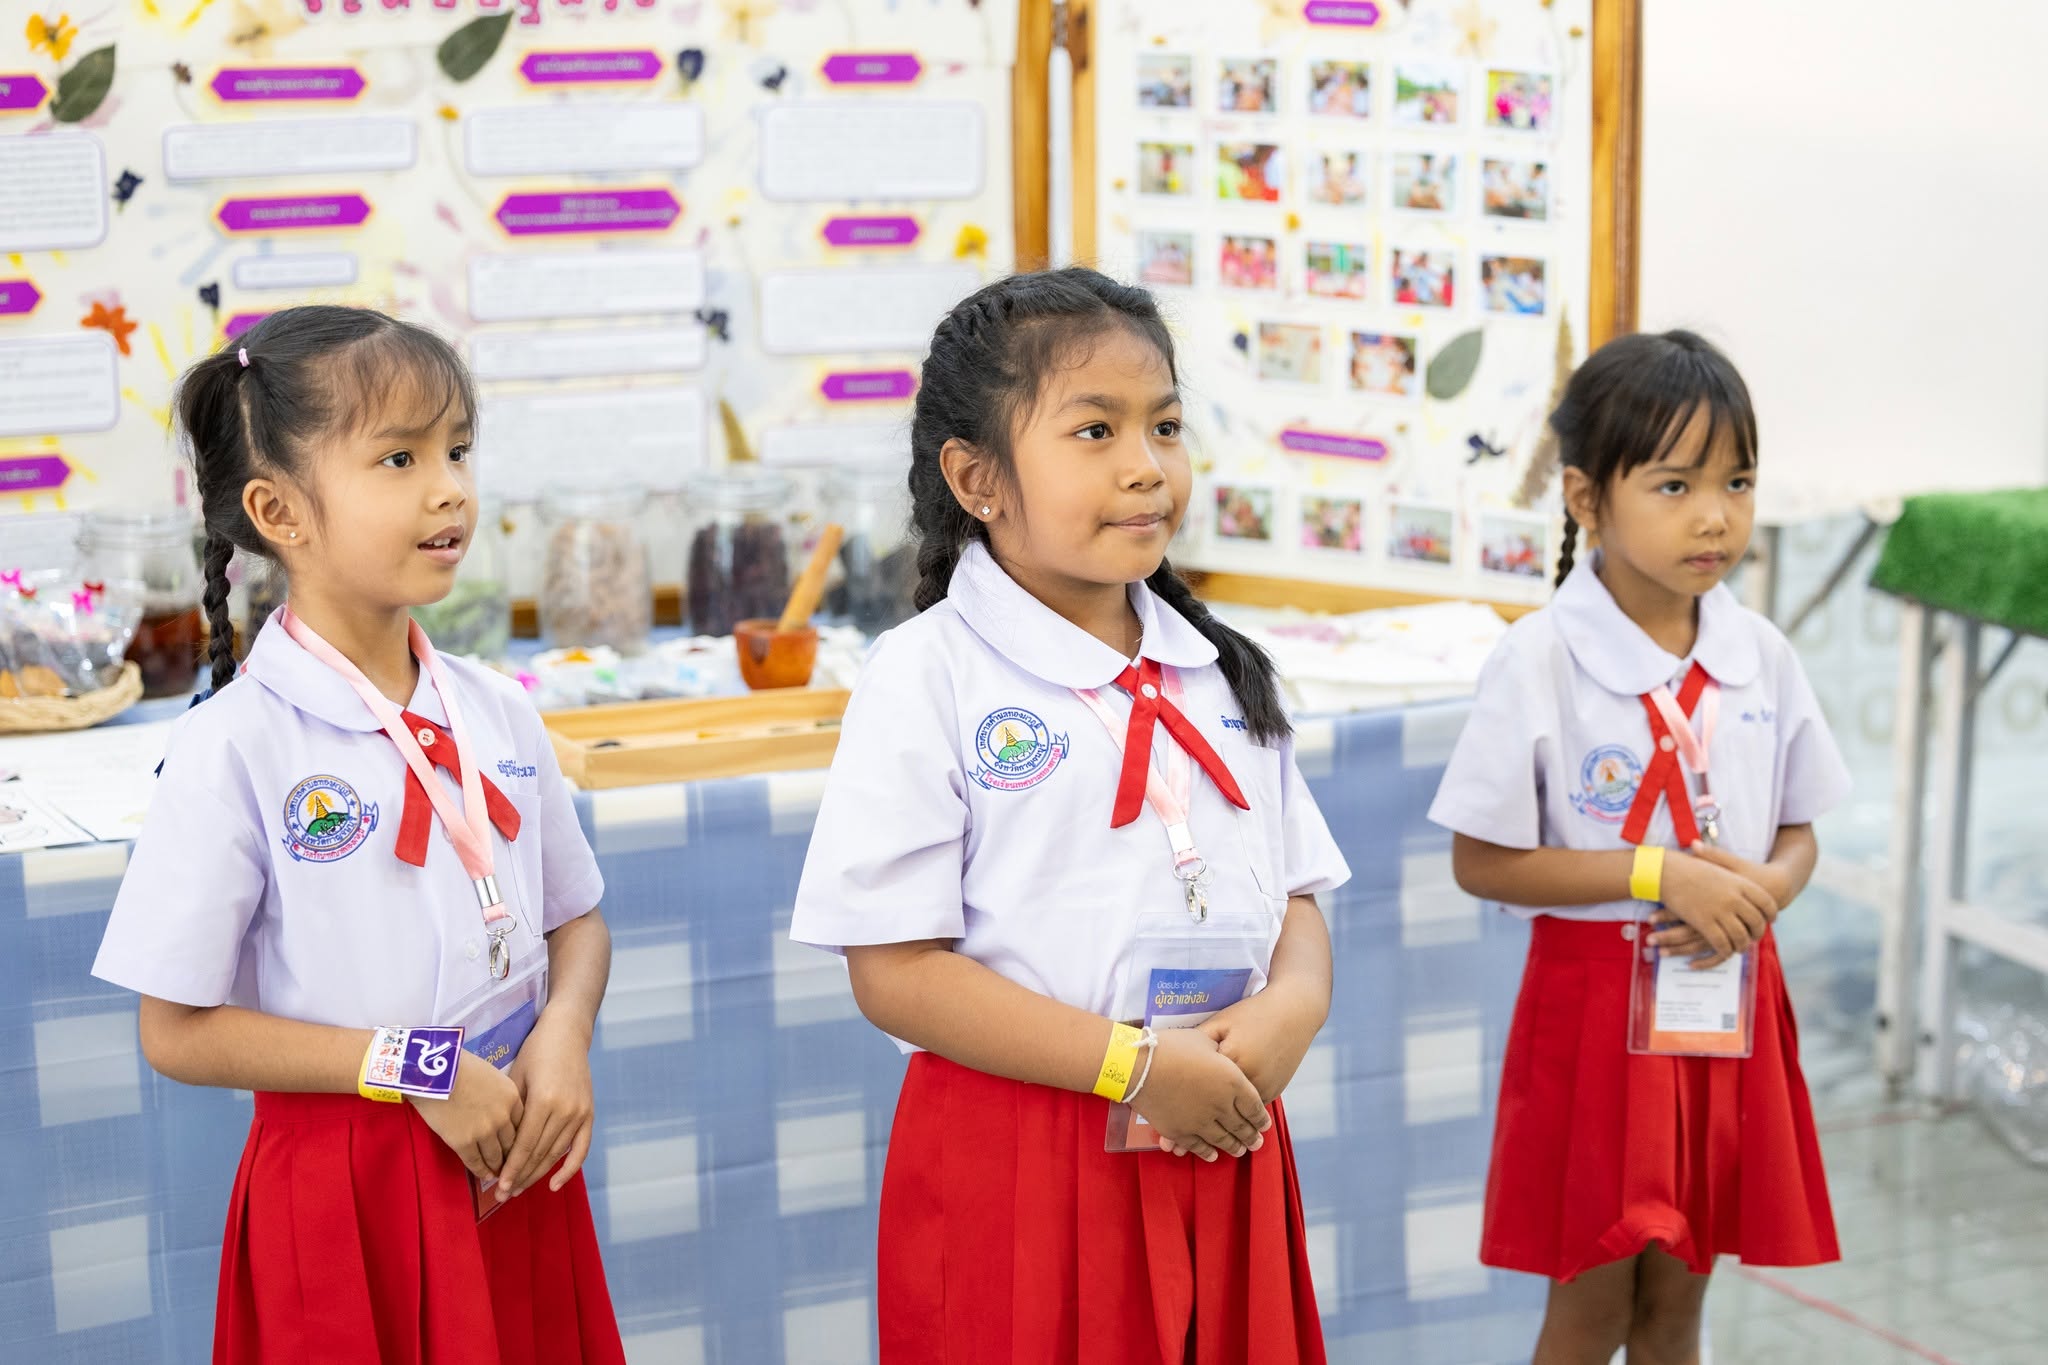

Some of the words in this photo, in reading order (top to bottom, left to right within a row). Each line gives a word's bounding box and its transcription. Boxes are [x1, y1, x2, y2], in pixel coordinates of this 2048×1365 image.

[1154, 991, 1210, 1008] ผู้เข้าแข่งขัน
